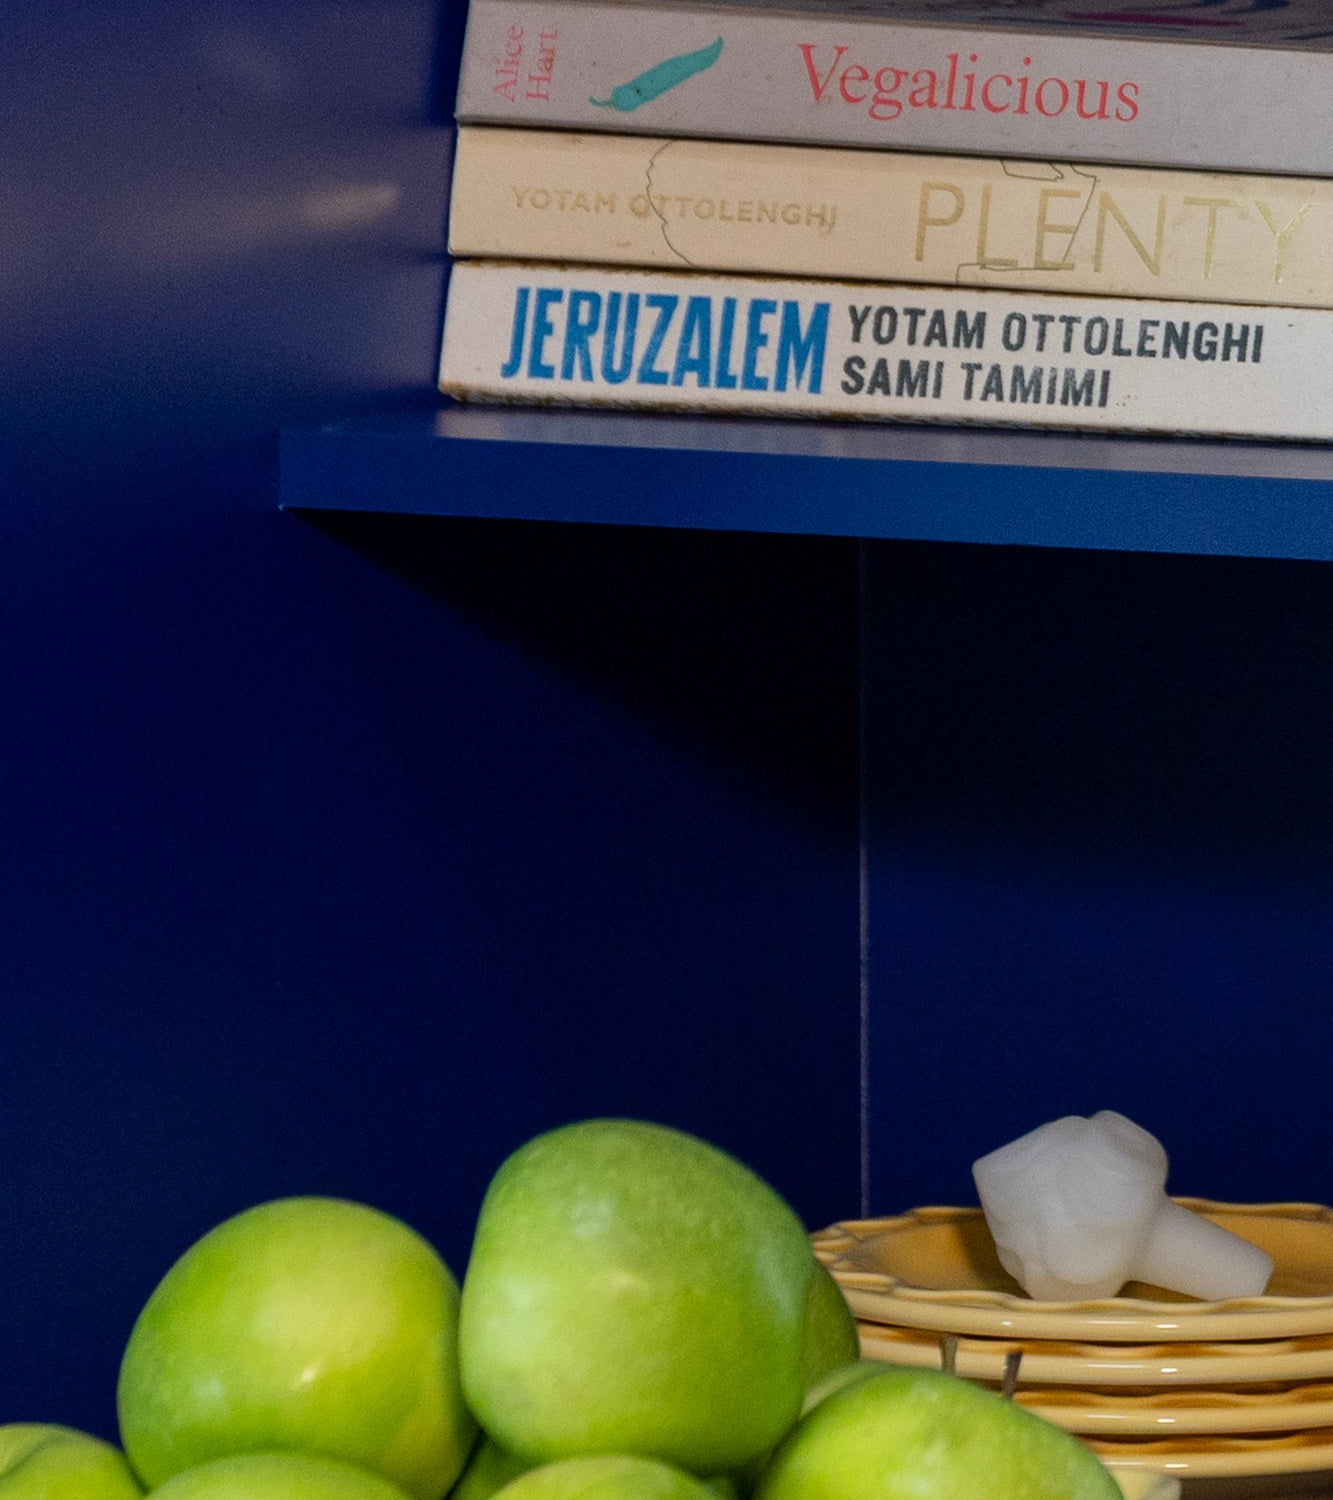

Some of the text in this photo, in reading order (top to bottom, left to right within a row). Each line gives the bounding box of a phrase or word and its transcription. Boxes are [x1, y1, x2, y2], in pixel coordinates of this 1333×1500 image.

[493, 24, 524, 102] Alice
[526, 28, 559, 102] Hart
[797, 43, 1141, 123] Vegalicious
[511, 185, 840, 230] YOTAM OTTOLENGHI
[913, 180, 1316, 285] PLENTY
[500, 286, 830, 396] JERUZALEM
[846, 304, 1266, 365] YOTAM OTTOLENGHI
[840, 357, 1113, 409] SAMI TAMIMI
